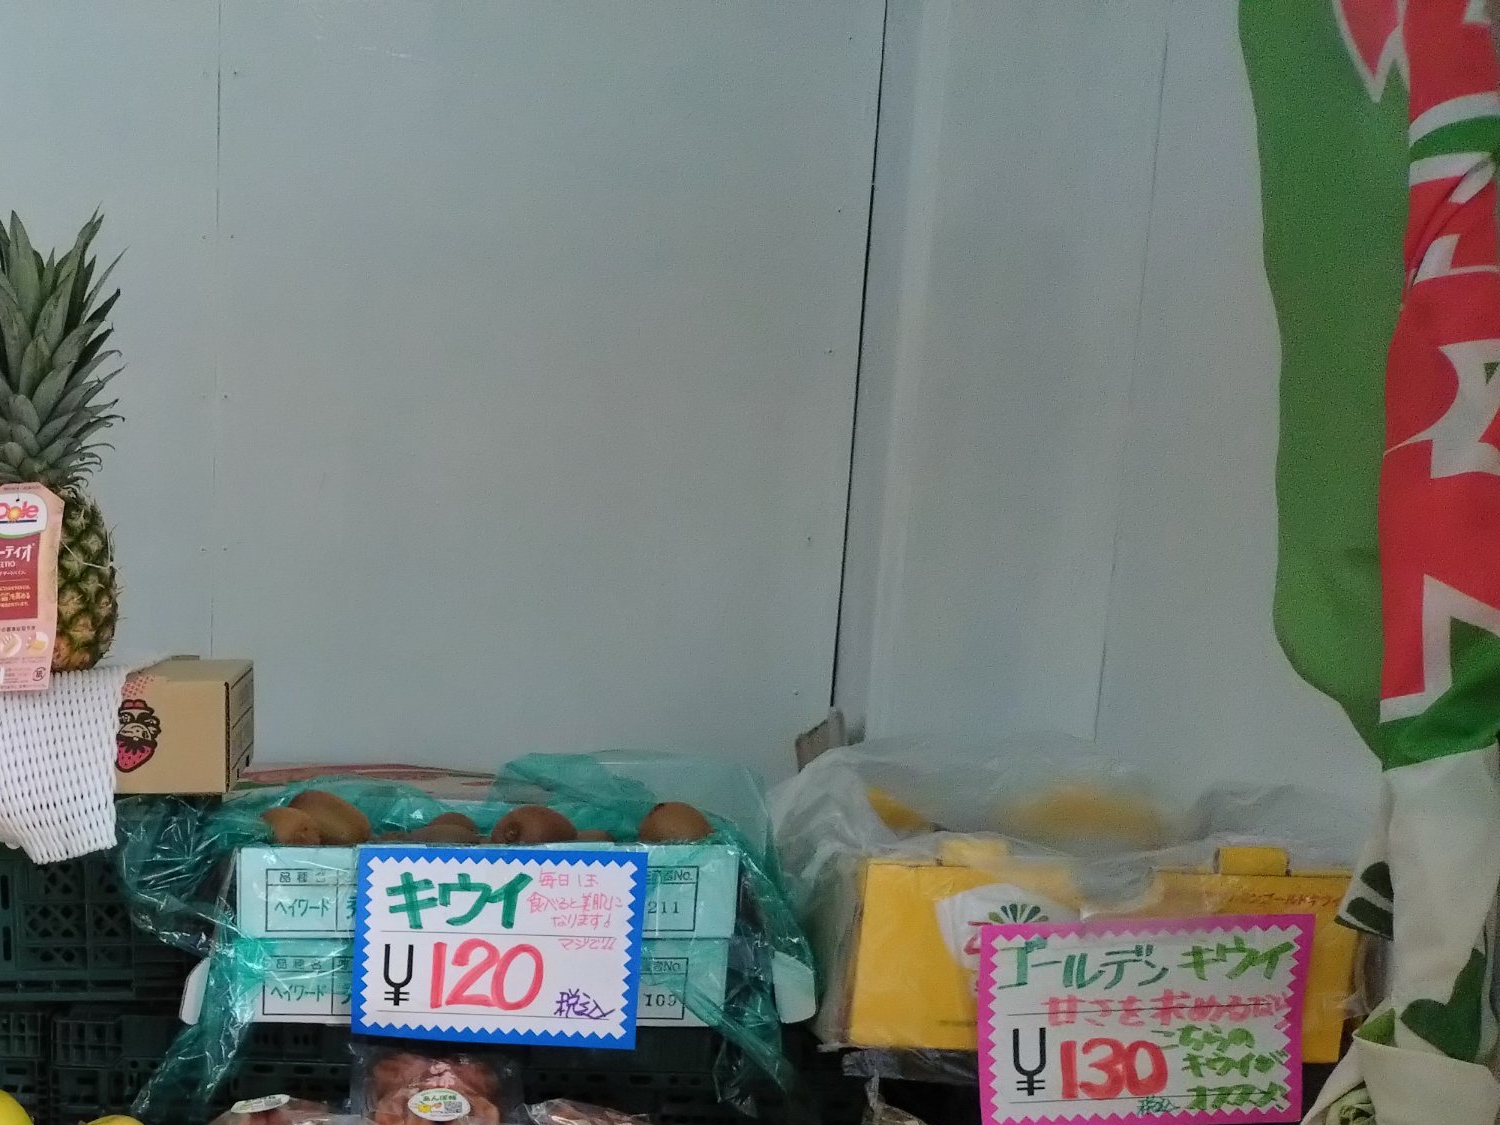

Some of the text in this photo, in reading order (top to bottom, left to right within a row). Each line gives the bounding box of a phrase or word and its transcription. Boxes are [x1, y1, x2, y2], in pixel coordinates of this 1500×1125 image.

[274, 898, 332, 918] ヘイワード
[385, 871, 534, 930] キウイ
[1178, 936, 1297, 982] キウイ
[554, 988, 616, 1020] 税込
